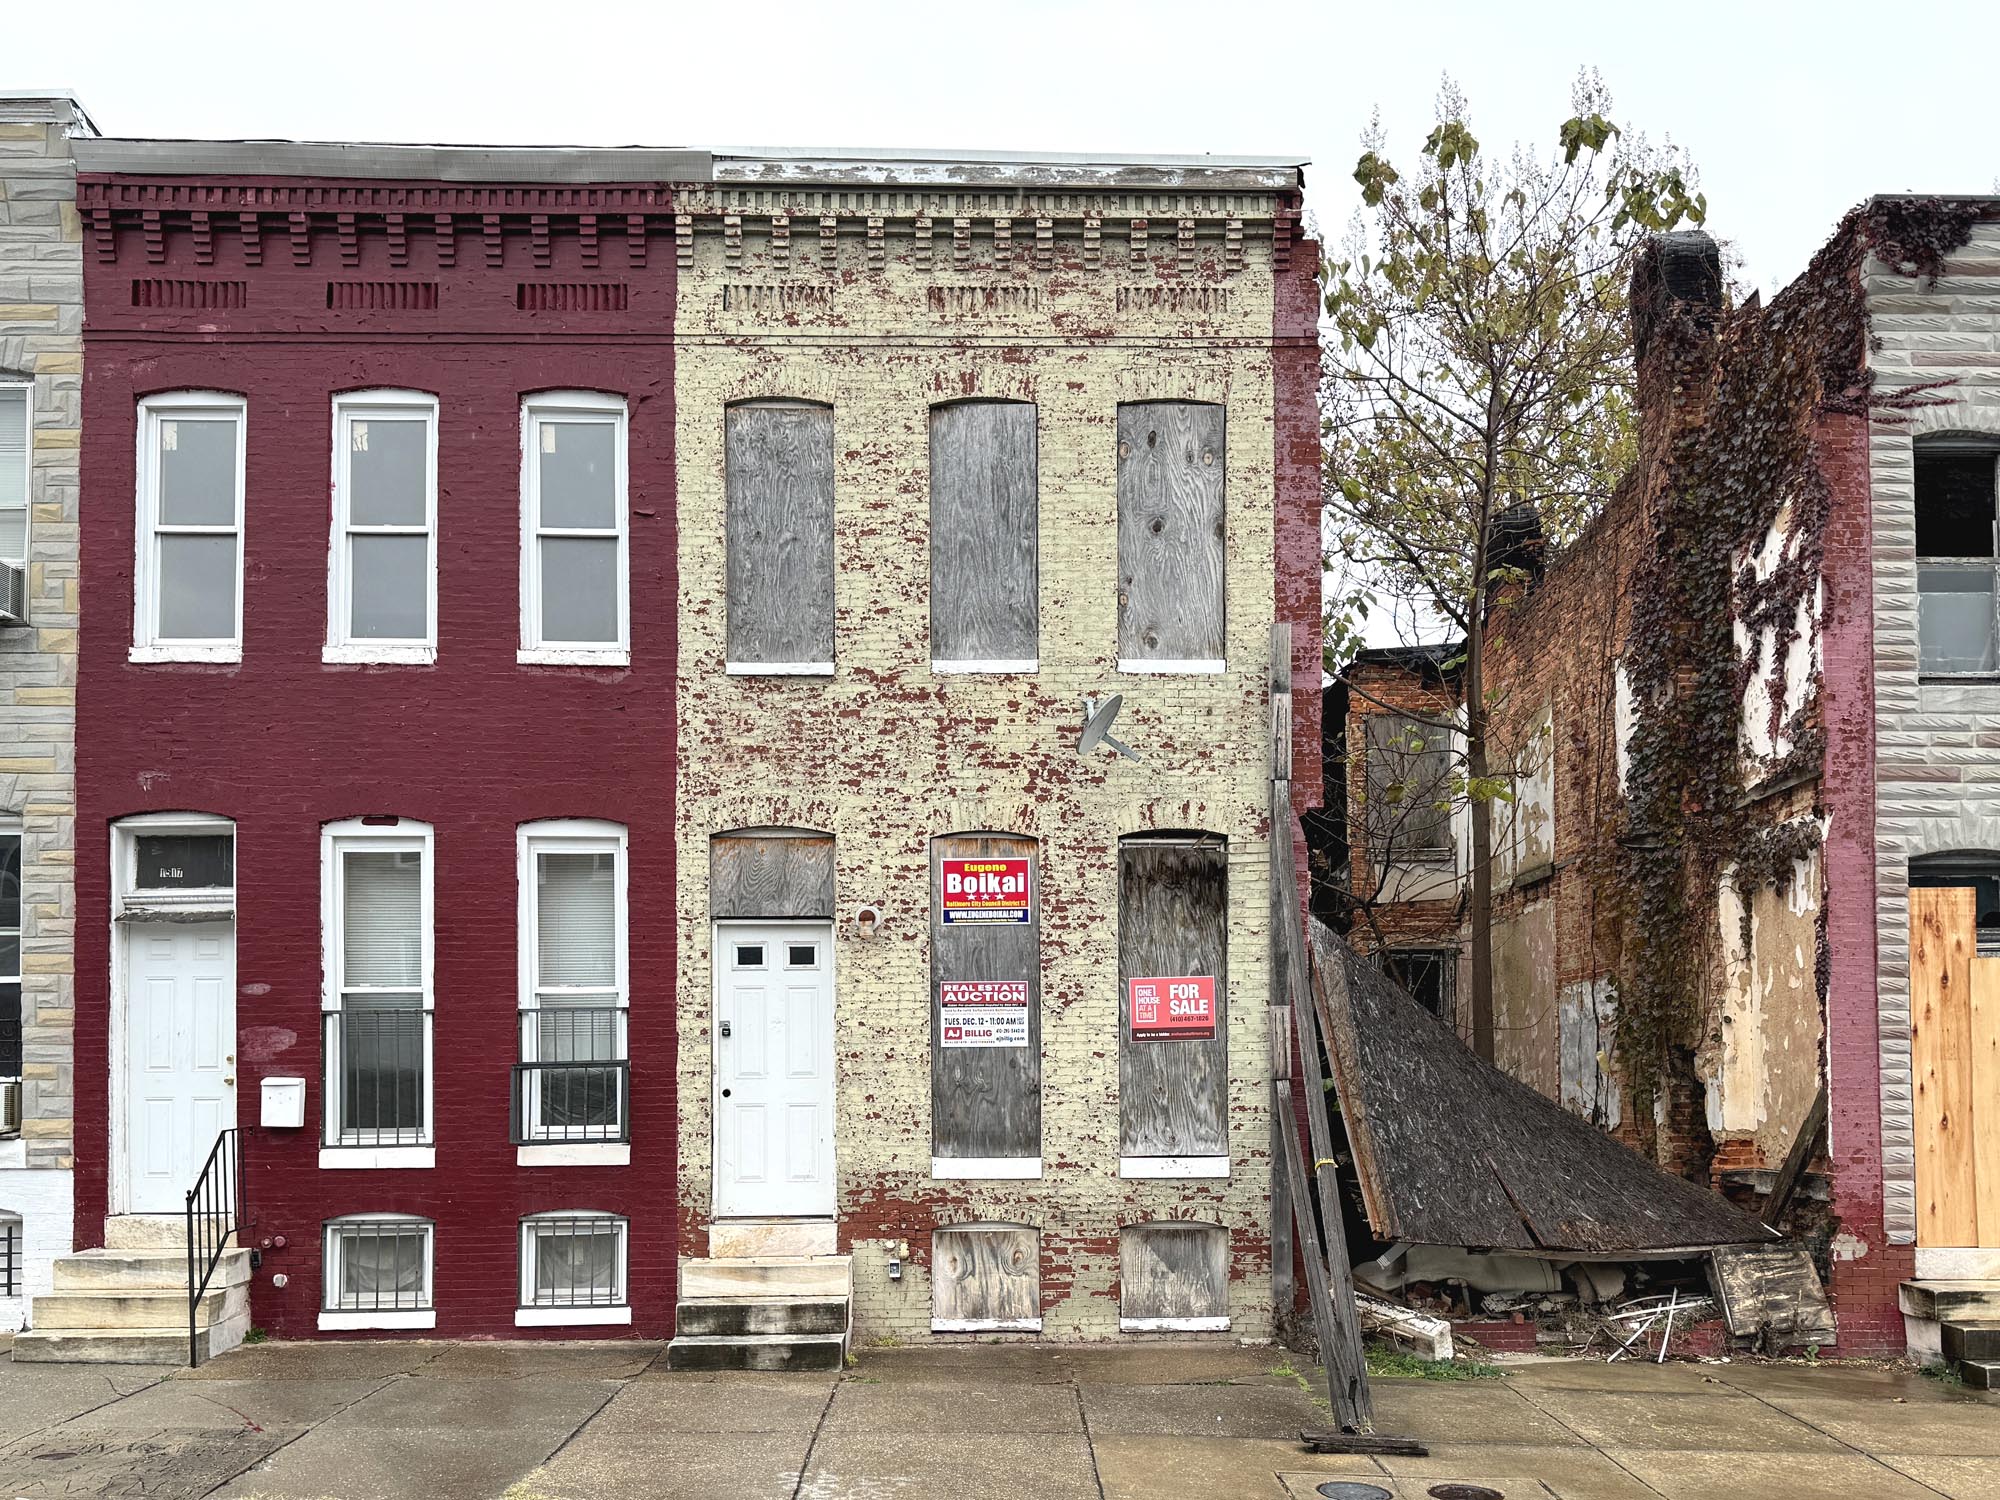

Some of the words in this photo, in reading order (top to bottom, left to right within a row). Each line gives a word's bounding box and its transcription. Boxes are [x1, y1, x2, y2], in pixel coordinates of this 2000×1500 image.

[964, 864, 1007, 872] Eugene
[947, 873, 1025, 893] Boikai
[944, 992, 1025, 1001] AUCTION
[1169, 984, 1199, 999] FOR
[1170, 999, 1209, 1015] SALE
